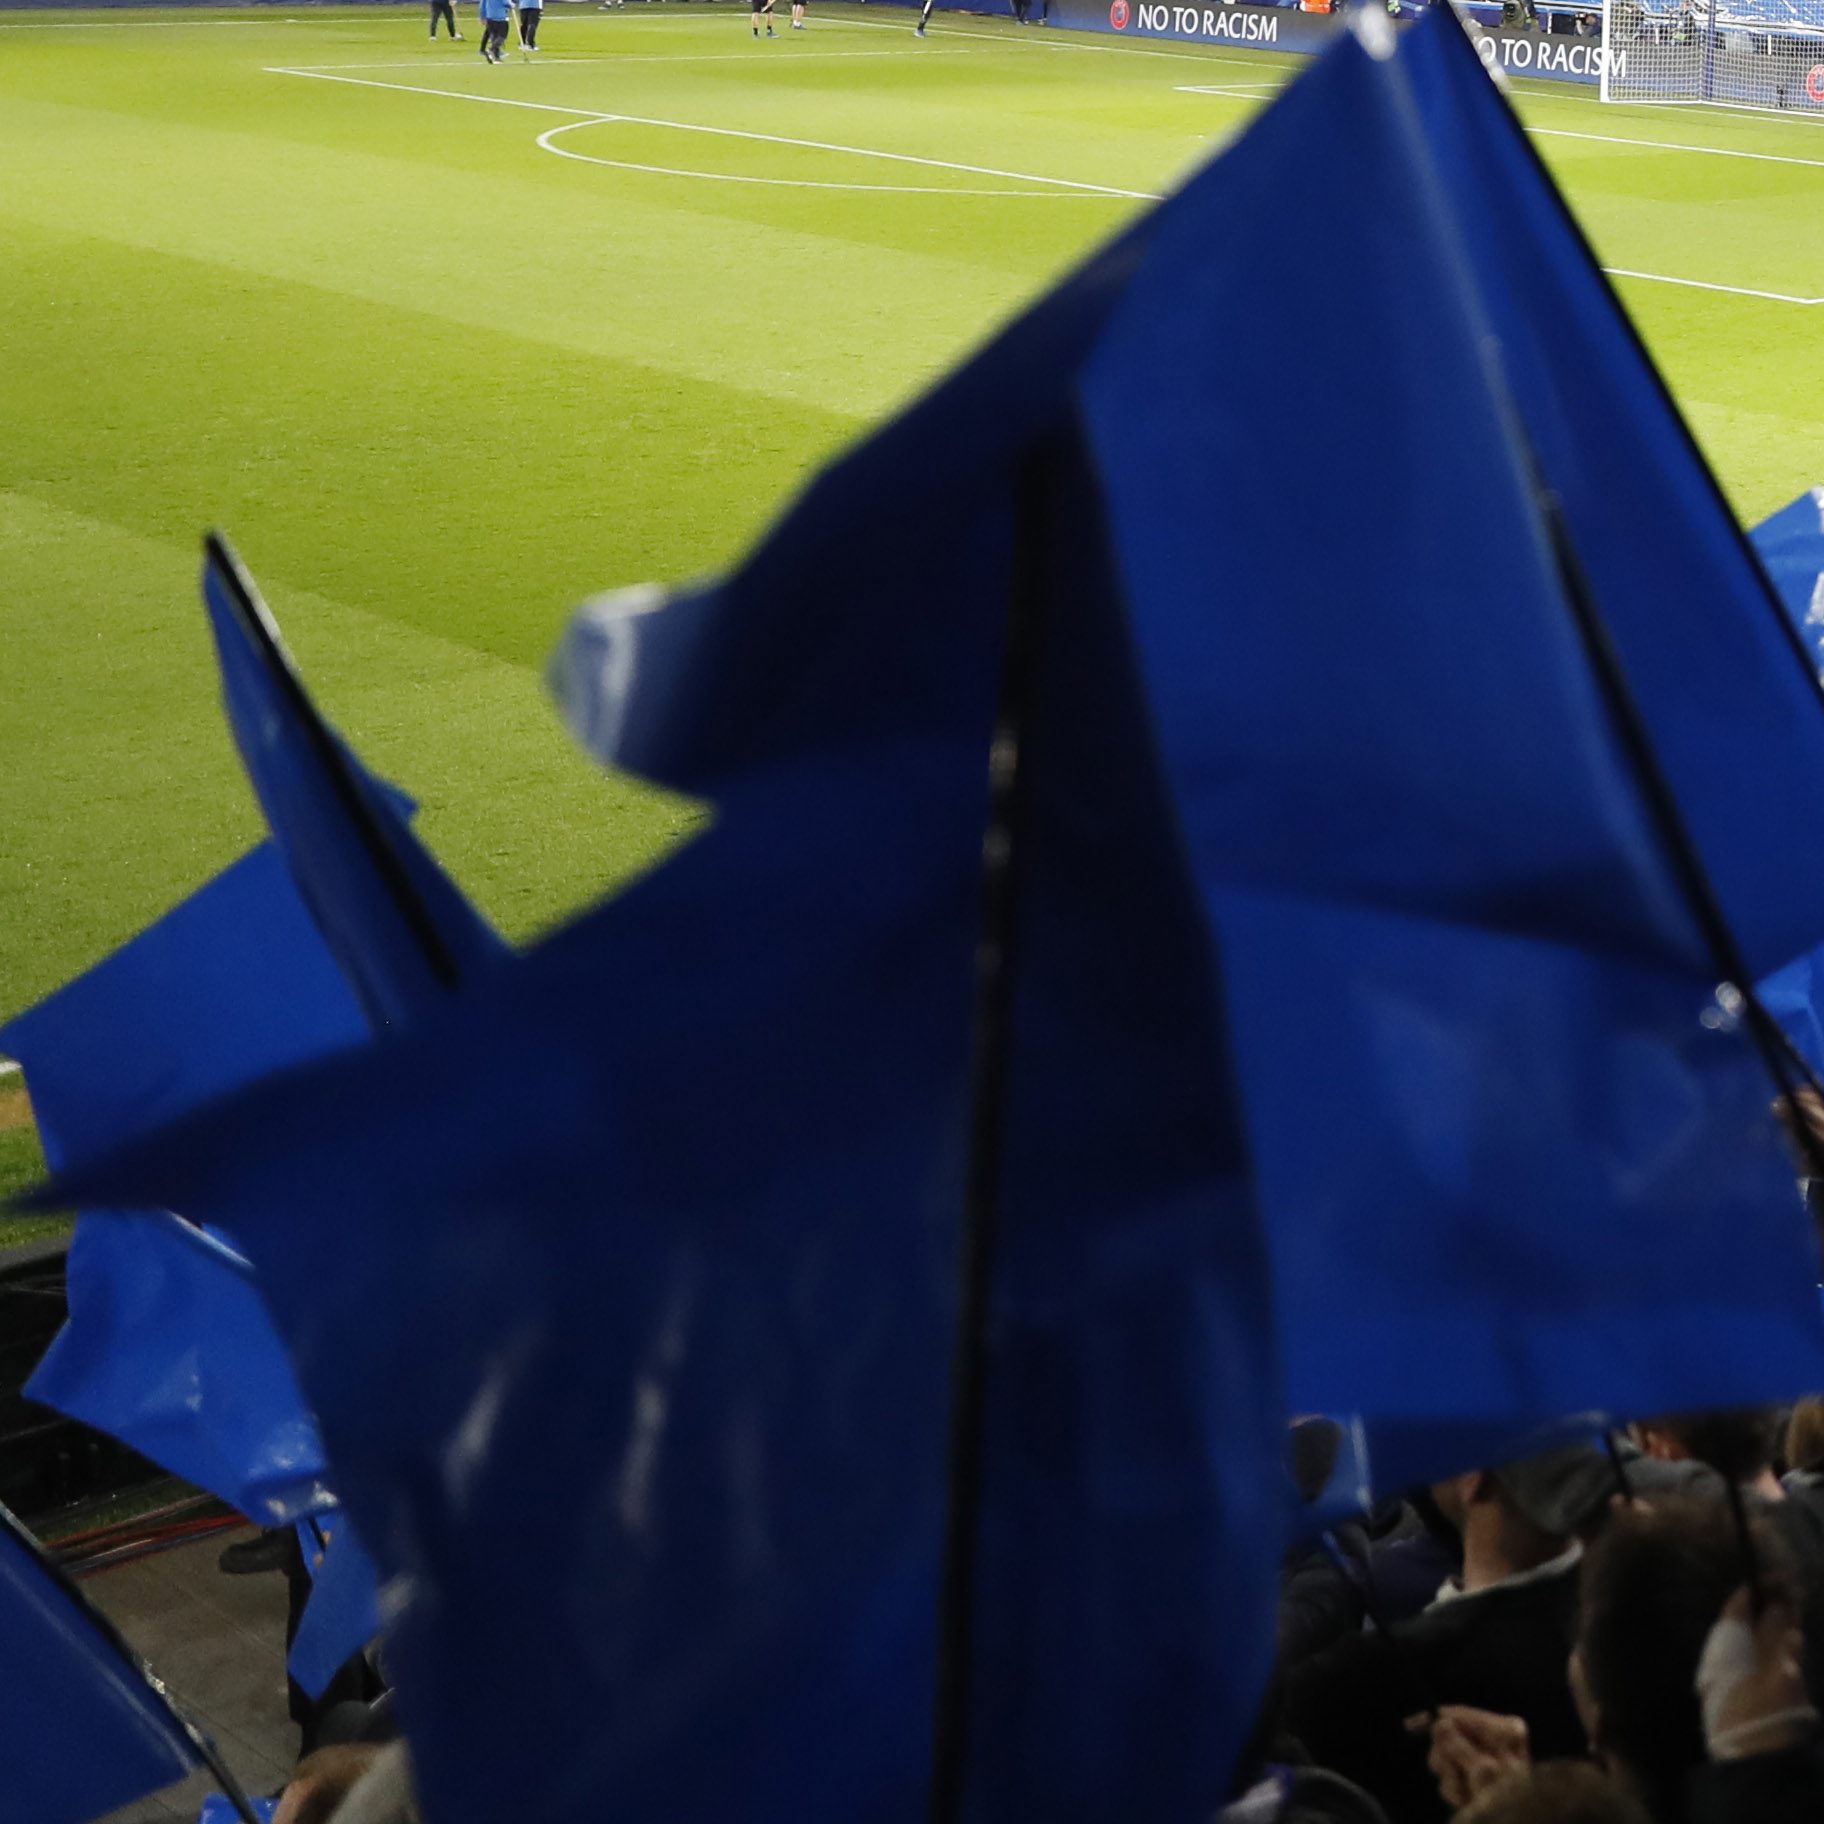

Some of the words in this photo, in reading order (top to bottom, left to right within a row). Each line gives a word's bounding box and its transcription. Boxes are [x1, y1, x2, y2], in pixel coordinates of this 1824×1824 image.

[1137, 4, 1169, 31] NO
[1173, 7, 1199, 34] TO
[1202, 10, 1278, 42] RACISM
[1501, 38, 1532, 68] TO
[1537, 42, 1627, 78] RACISM
